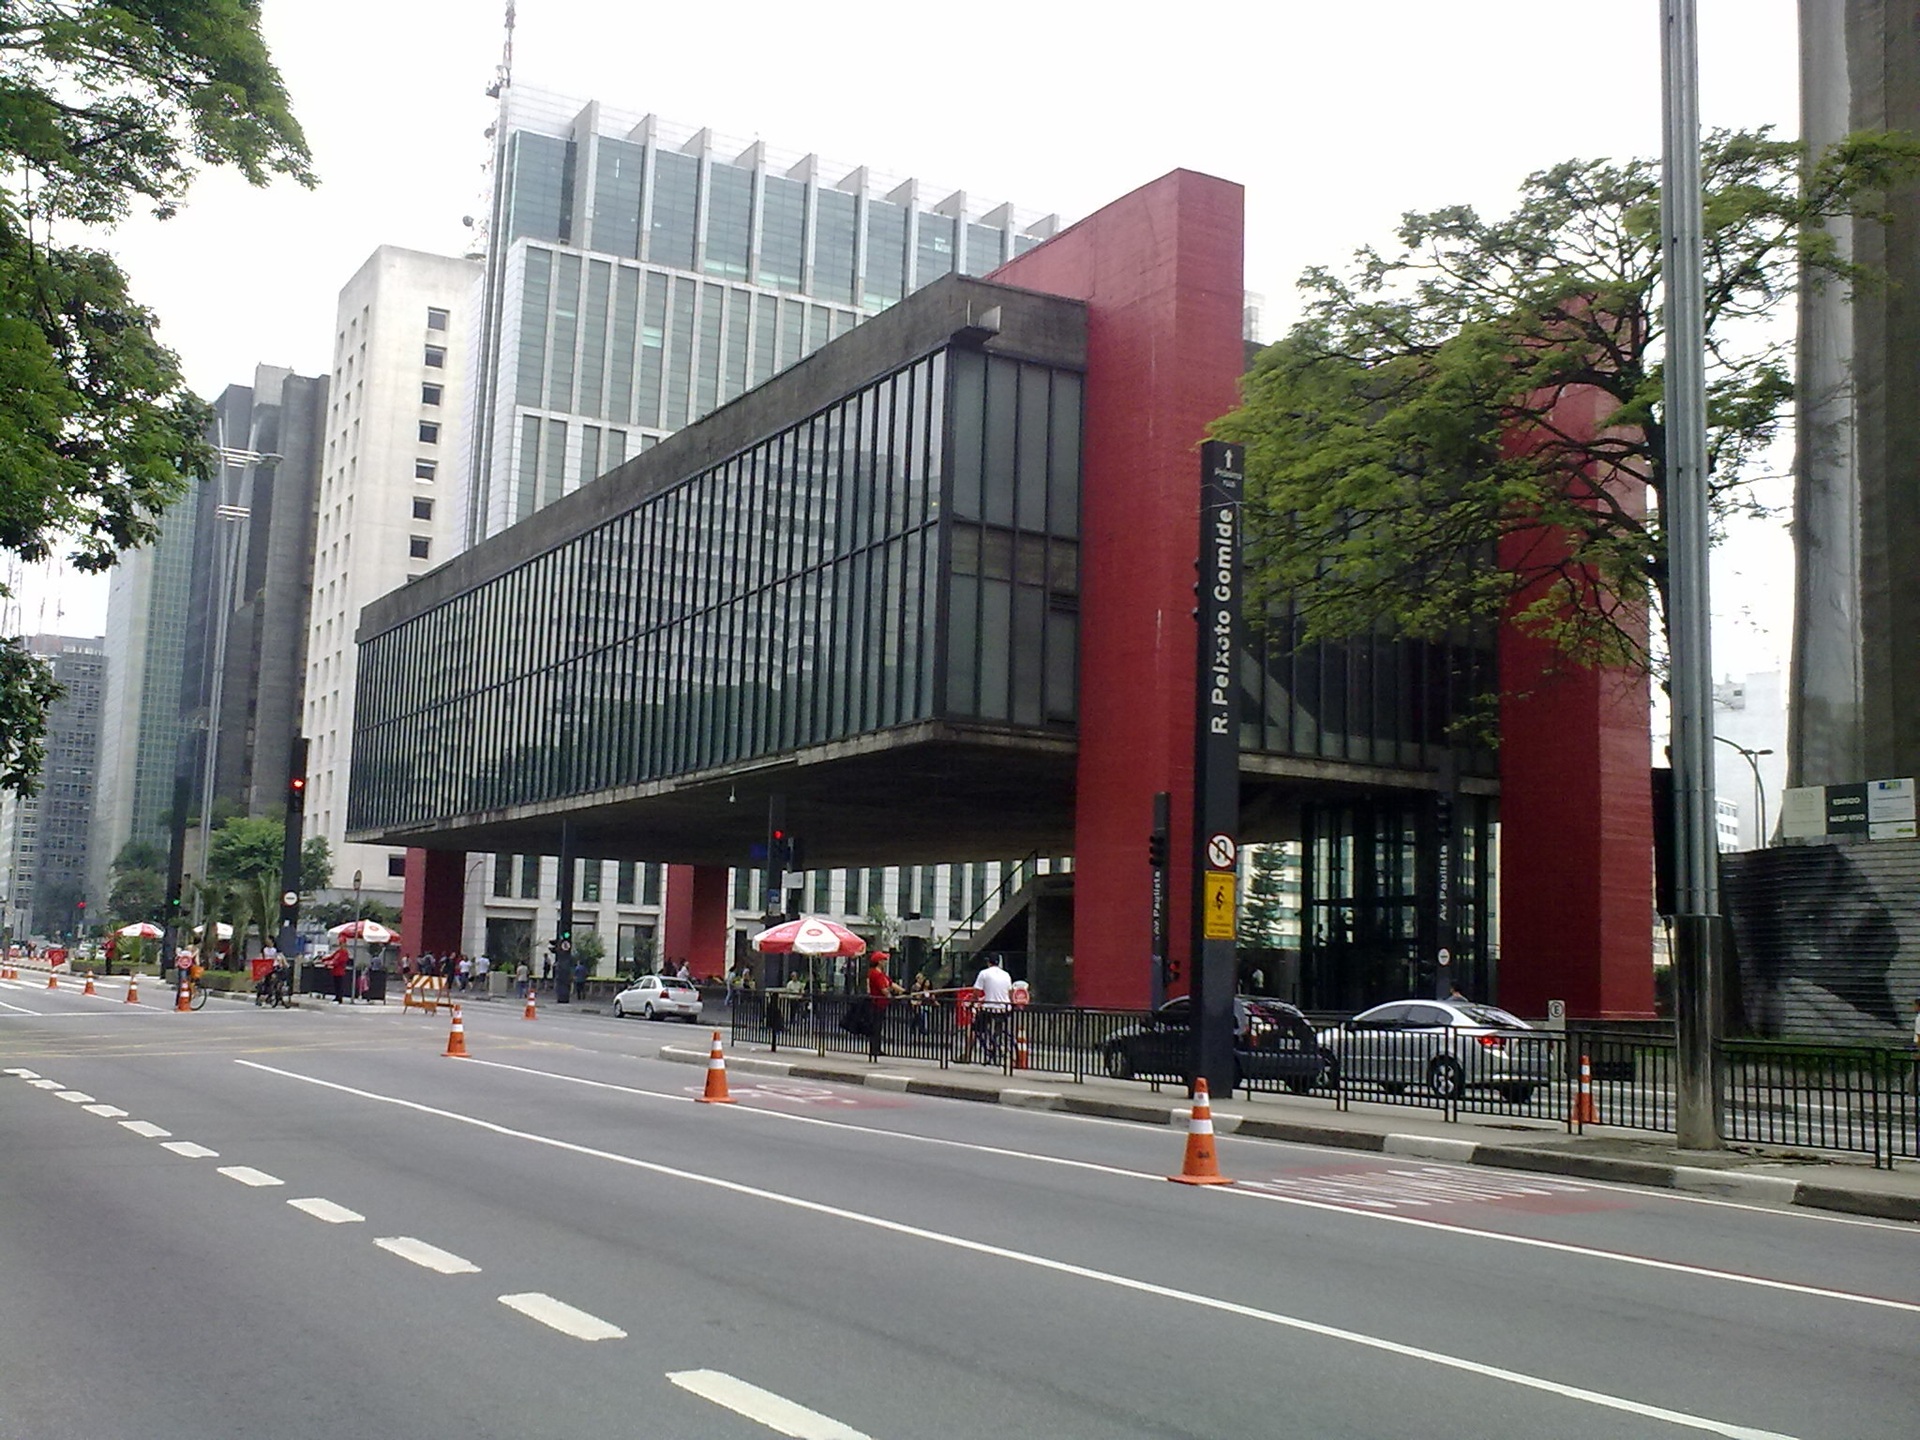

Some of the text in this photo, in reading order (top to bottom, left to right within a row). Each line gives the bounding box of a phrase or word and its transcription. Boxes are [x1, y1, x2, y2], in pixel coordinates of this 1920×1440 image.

[1211, 508, 1234, 734] R. Peixoto Gomide
